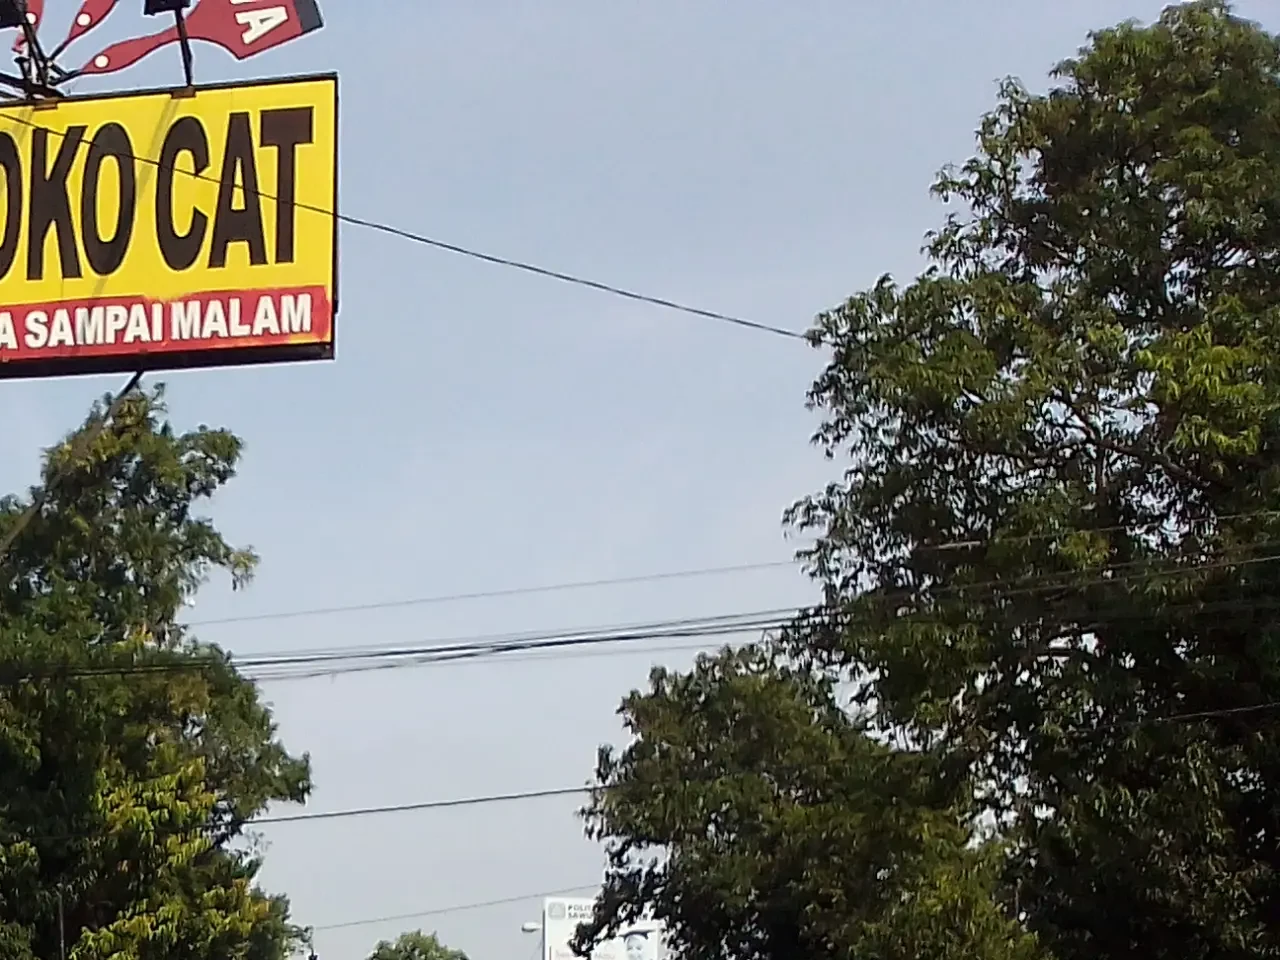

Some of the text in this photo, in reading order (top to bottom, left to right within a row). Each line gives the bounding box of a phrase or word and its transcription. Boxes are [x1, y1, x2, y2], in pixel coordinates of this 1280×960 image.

[155, 106, 314, 271] CAT
[24, 302, 163, 348] SAMPAI
[170, 294, 312, 341] MALAM
